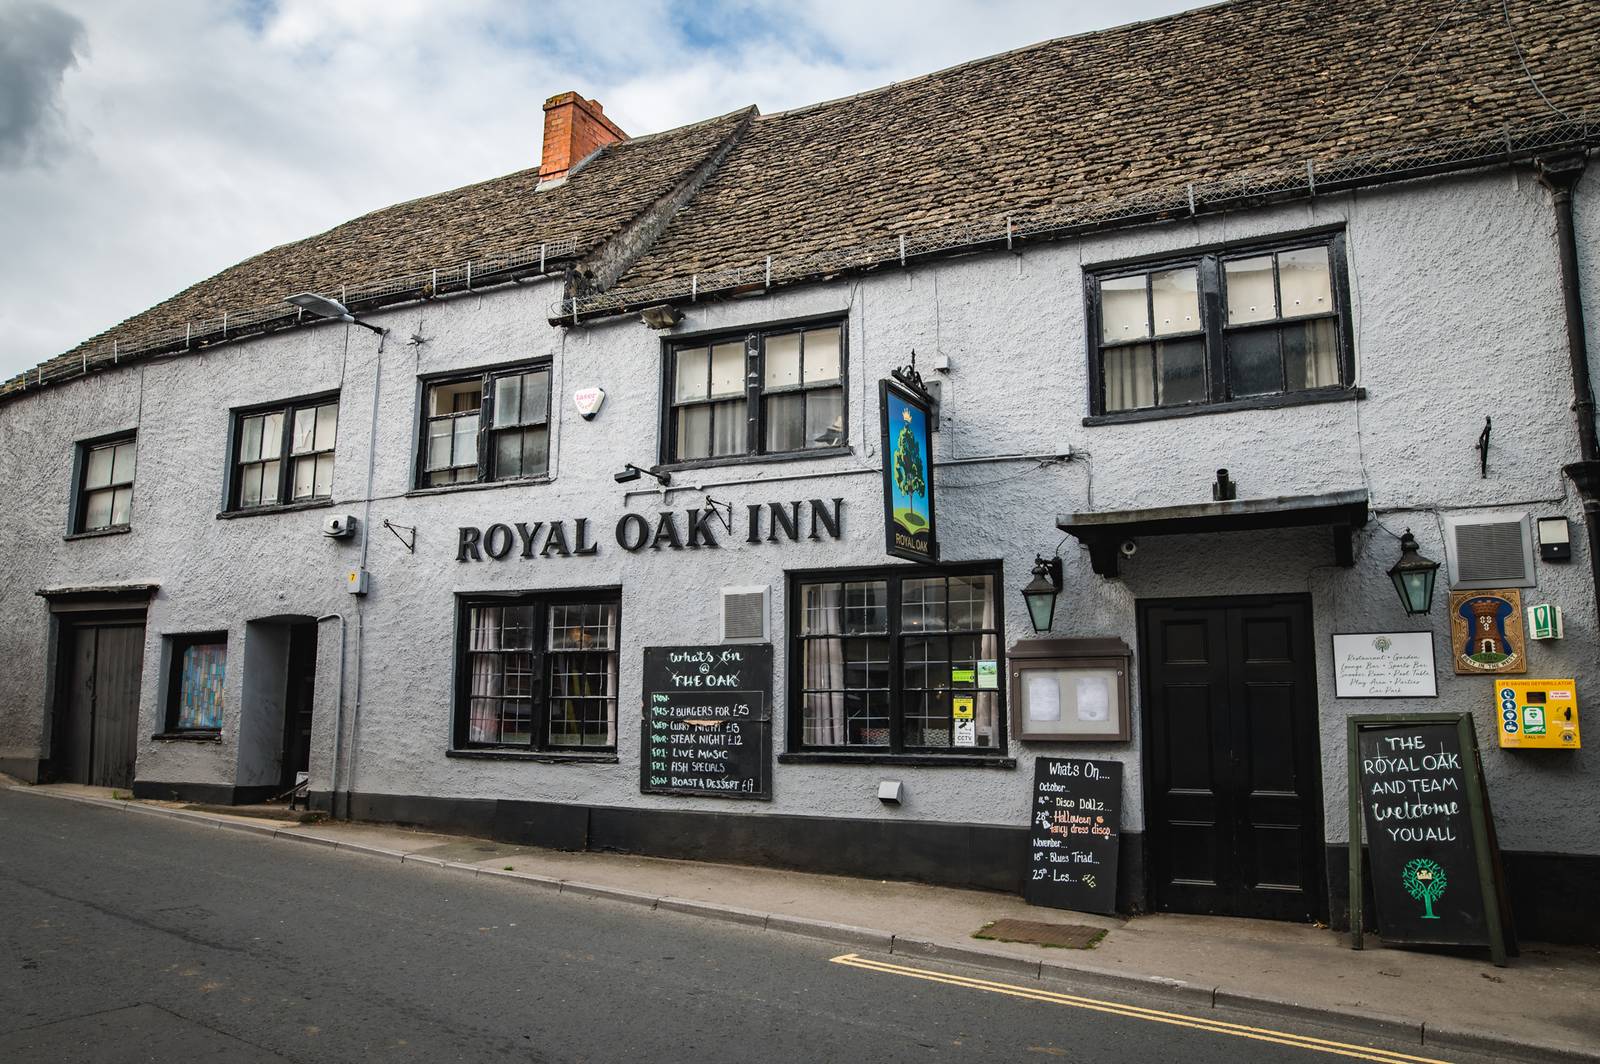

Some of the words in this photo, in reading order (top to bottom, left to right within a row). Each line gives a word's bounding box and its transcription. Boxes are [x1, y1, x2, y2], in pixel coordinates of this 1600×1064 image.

[456, 517, 597, 561] ROYAL
[615, 509, 719, 551] OAK
[746, 497, 844, 543] INN
[896, 532, 915, 549] ROYAL
[915, 539, 929, 553] OAK
[699, 663, 710, 674] @
[673, 674, 703, 687] THE
[706, 674, 738, 687] OAK
[670, 706, 675, 716] 2
[676, 706, 713, 716] BURGERS
[715, 706, 730, 716] FOR
[733, 703, 750, 717] £25
[670, 734, 697, 744] STEAK
[699, 735, 726, 746] NIGHT
[728, 735, 743, 746] £12
[1385, 735, 1425, 751] THE
[672, 748, 695, 759] LIVE
[697, 750, 728, 760] MUSIC
[671, 761, 688, 773] FISH
[691, 761, 726, 773] SPECIALS
[1049, 762, 1079, 776] Whats
[1364, 758, 1420, 775] ROYAL
[1422, 753, 1461, 771] OAK
[671, 776, 698, 788] ROAST
[706, 778, 740, 790] DESSERT
[1371, 780, 1406, 796] AND
[1408, 777, 1459, 793] TEAM
[1055, 798, 1075, 808] Disco
[1053, 810, 1092, 825] Halloween
[1049, 822, 1069, 838] fancy
[1070, 824, 1089, 834] dress
[1388, 828, 1424, 842] YOU
[1425, 827, 1456, 841] ALL
[1049, 852, 1070, 863] Blues
